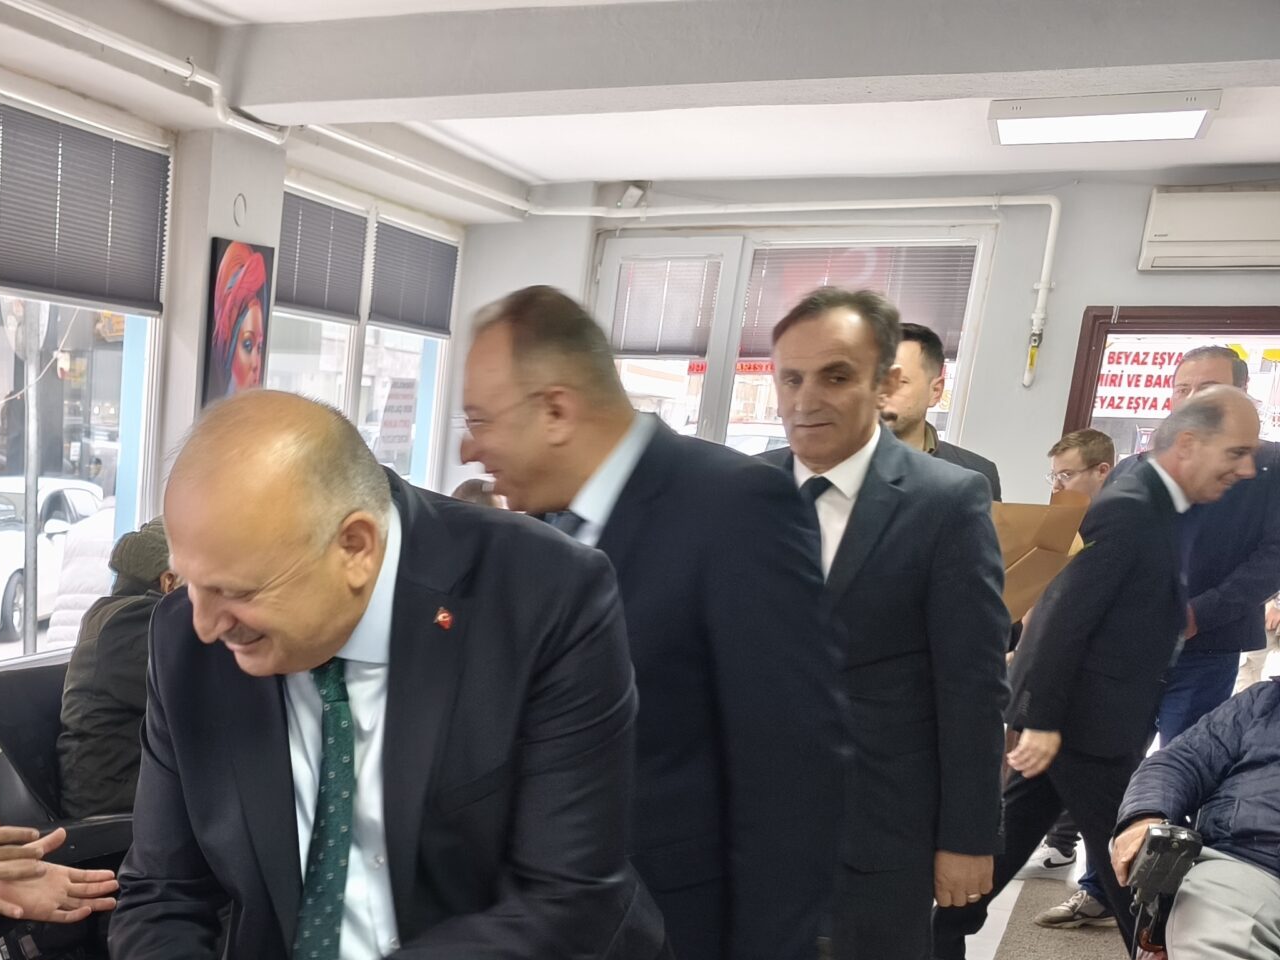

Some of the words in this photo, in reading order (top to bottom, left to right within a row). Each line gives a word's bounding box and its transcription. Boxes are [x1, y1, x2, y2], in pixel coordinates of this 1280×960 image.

[1107, 351, 1150, 365] BEYAZ
[1127, 374, 1142, 388] VE
[1144, 374, 1173, 388] BAK
[1126, 396, 1157, 414] EŞYA
